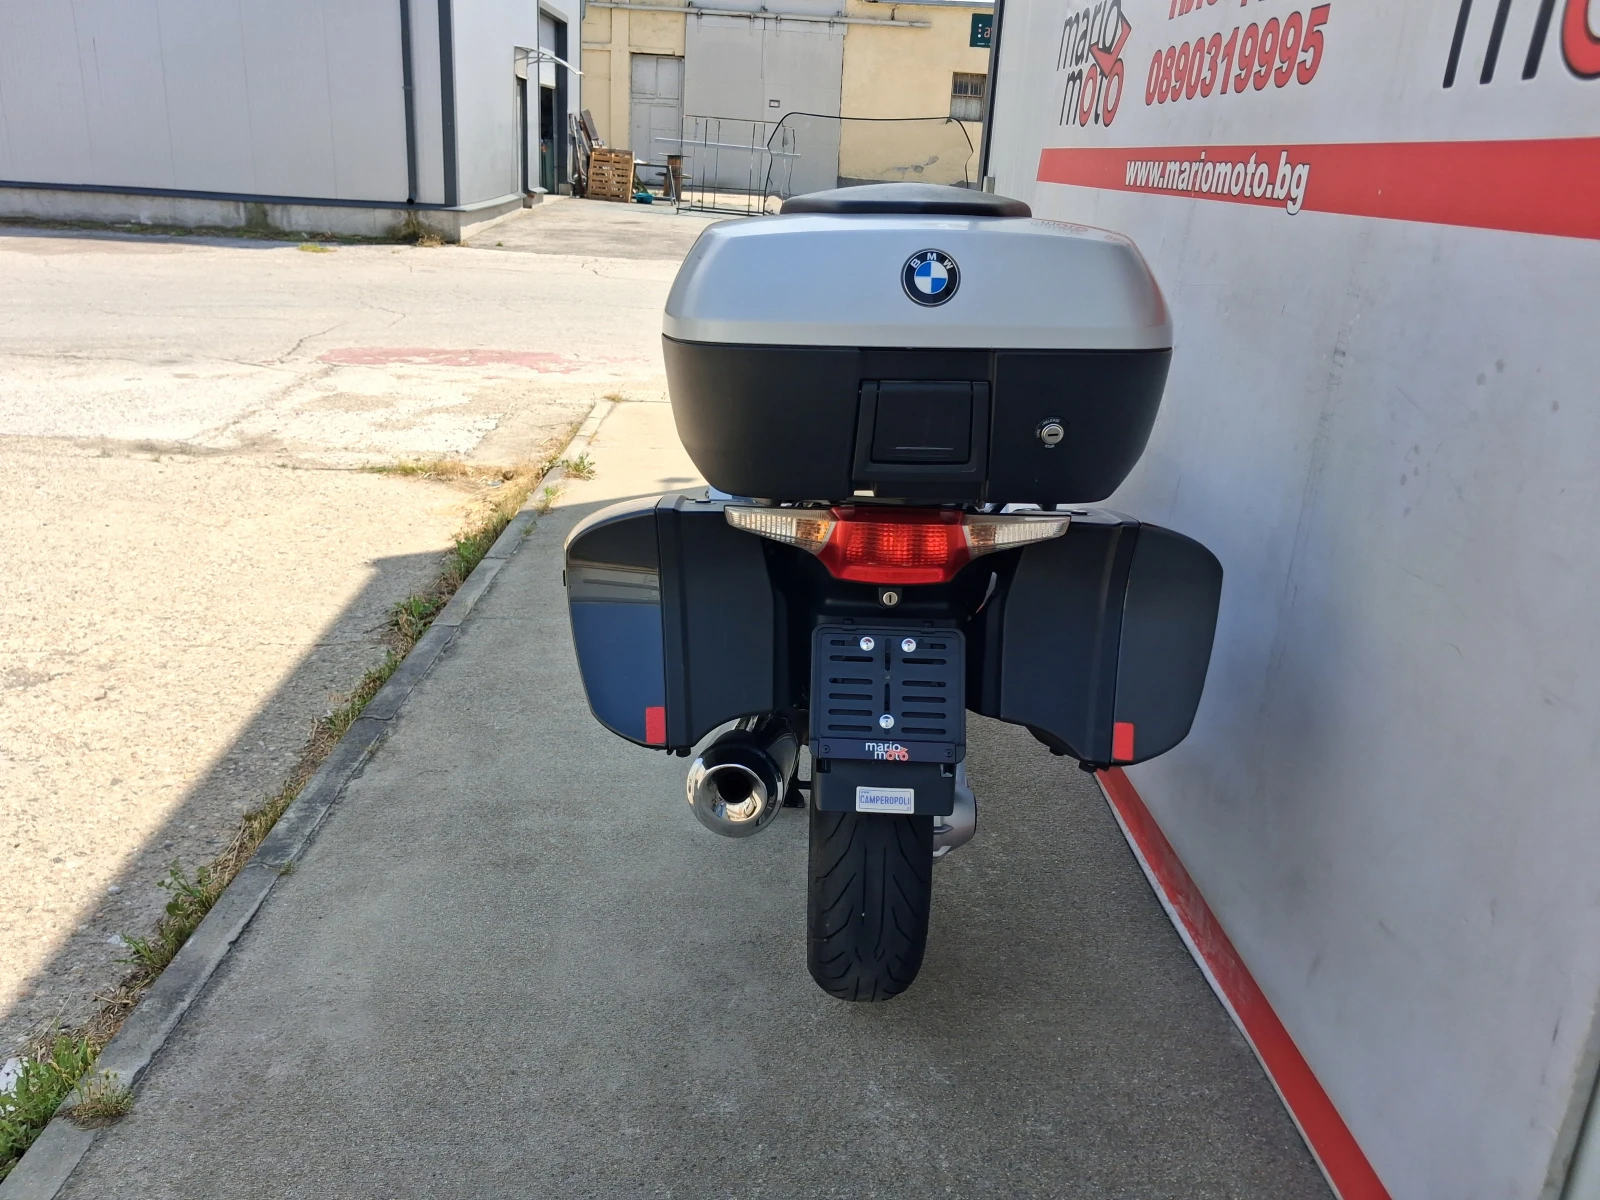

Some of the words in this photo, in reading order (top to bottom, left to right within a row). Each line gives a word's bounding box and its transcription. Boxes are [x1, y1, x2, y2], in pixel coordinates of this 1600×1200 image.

[1057, 0, 1121, 71] mario
[1145, 3, 1331, 106] 0890319995
[1060, 58, 1124, 127] moto
[1125, 151, 1310, 215] www.mariomoto.bg
[910, 252, 953, 270] BMW
[865, 741, 901, 752] mario
[874, 750, 909, 761] moto
[860, 795, 910, 806] CAMPEROPOLI
